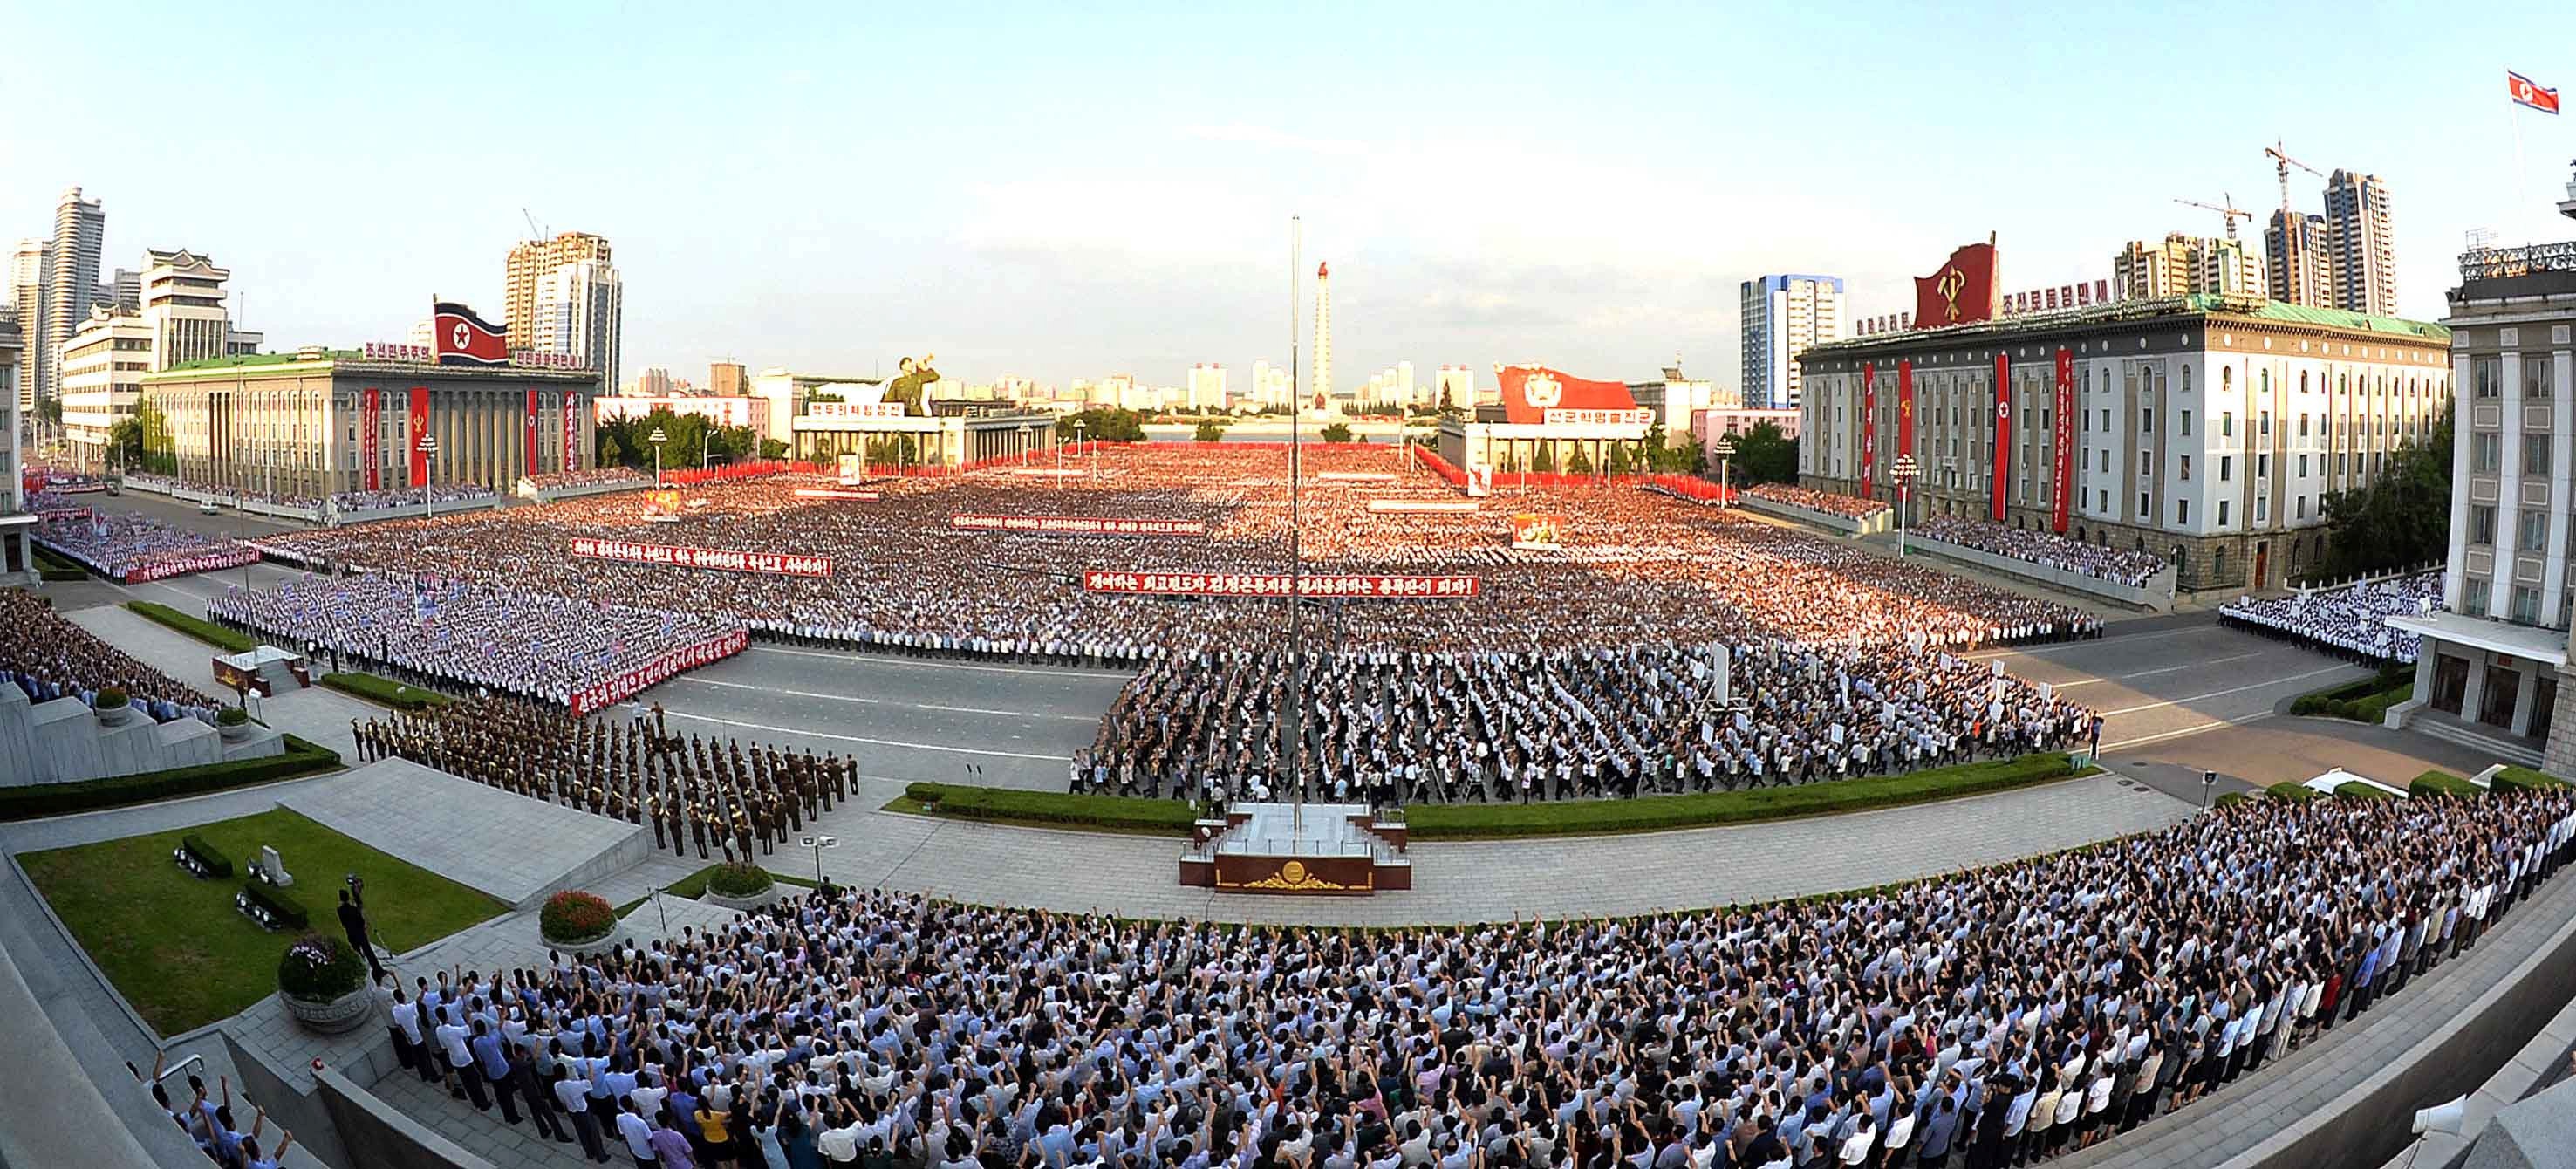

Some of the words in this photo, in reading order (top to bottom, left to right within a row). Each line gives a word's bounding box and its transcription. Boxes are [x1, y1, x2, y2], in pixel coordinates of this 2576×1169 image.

[366, 342, 430, 360] 조선민주주의
[1549, 411, 1650, 424] 선군혁명총진군
[784, 557, 829, 576] 사수하자!
[1089, 572, 1138, 590] 경애하는
[1144, 575, 1206, 591] 최고령도자
[1206, 575, 1293, 594] 김정은동지를
[1296, 578, 1374, 595] 결사옹위하는
[1377, 578, 1432, 595] 총폭탄이
[1436, 577, 1472, 595] 되자!
[579, 683, 609, 713] 선군의
[609, 672, 646, 700] 위력으로
